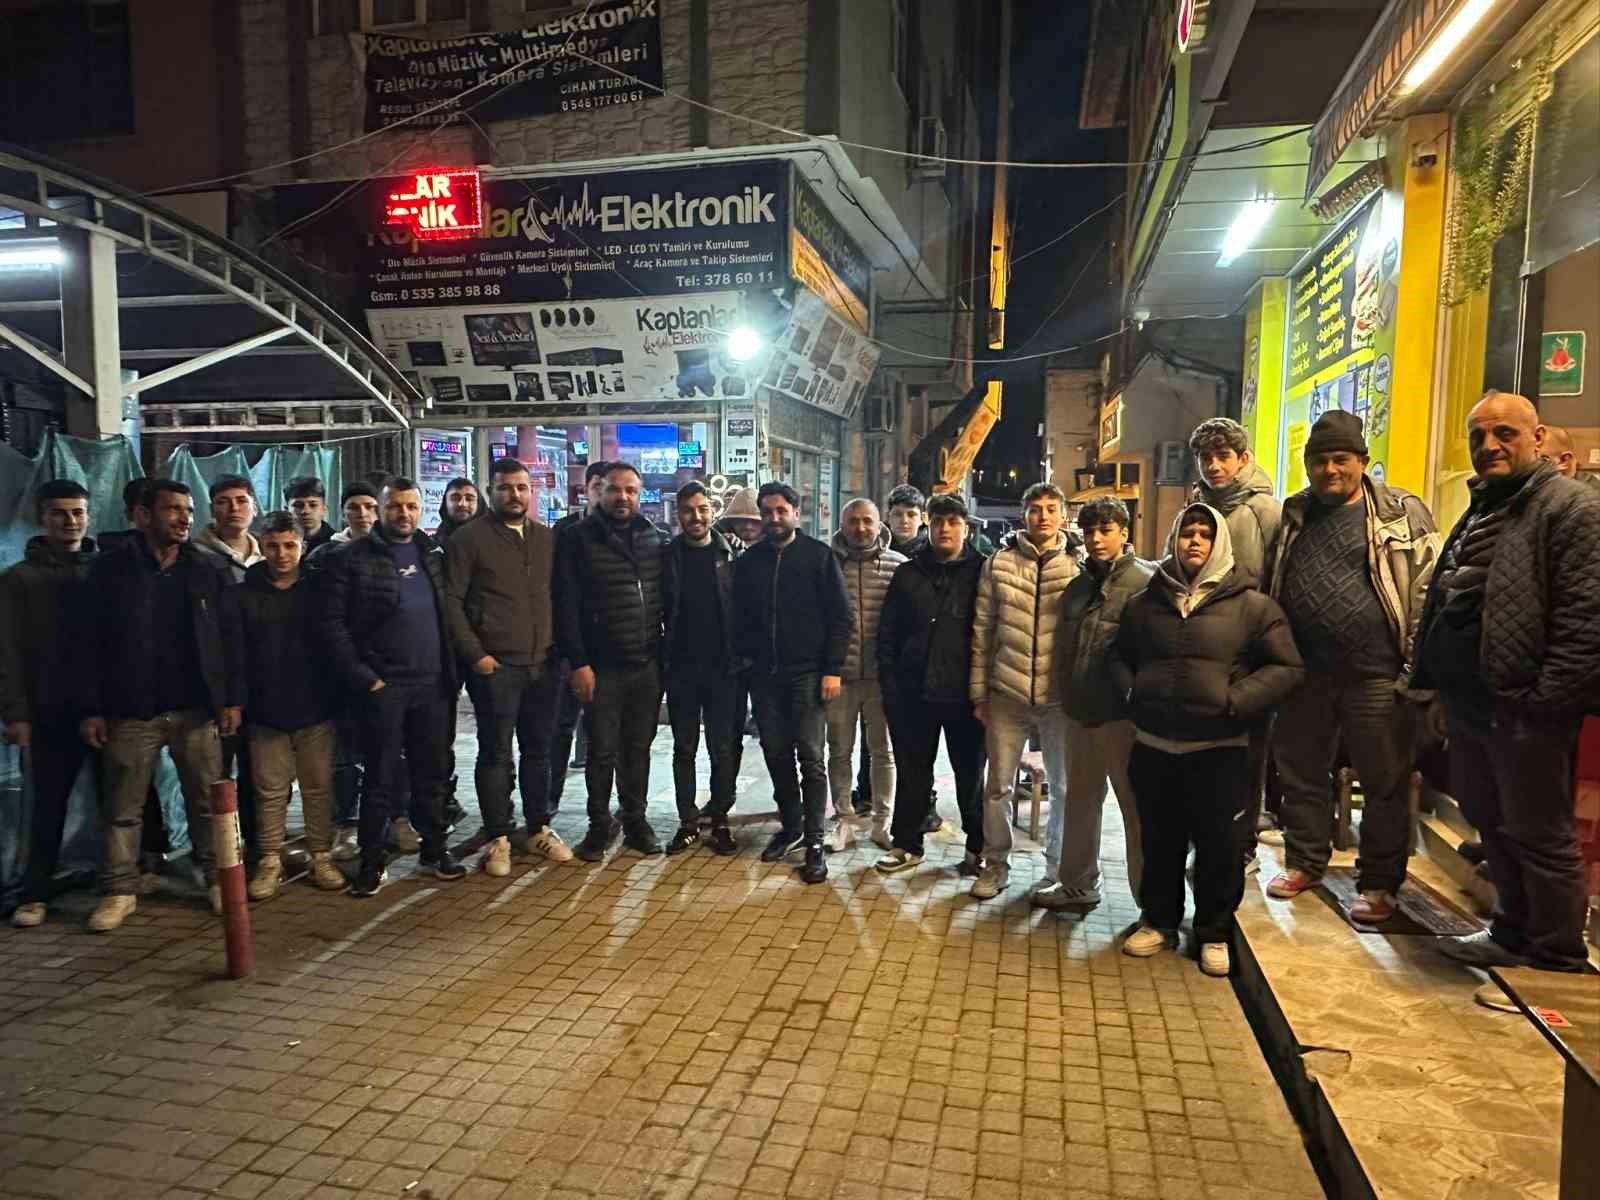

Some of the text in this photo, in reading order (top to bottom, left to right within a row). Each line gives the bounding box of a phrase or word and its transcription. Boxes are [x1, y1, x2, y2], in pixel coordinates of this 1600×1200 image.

[436, 54, 486, 74] Müzik
[601, 186, 775, 233] Elektronik
[548, 247, 589, 258] Sistemleri
[604, 239, 750, 255] LED LCD TV Tamiri ve Kurulumu
[551, 262, 573, 274] Uydu
[633, 259, 654, 271] Araç
[656, 258, 689, 268] Kamera
[702, 255, 728, 267] Takip
[729, 251, 774, 264] Sistemleri
[676, 270, 774, 287] Tel: 378 60 11
[370, 290, 399, 302] Gsm:
[411, 287, 435, 299] 535
[437, 286, 462, 298] 385
